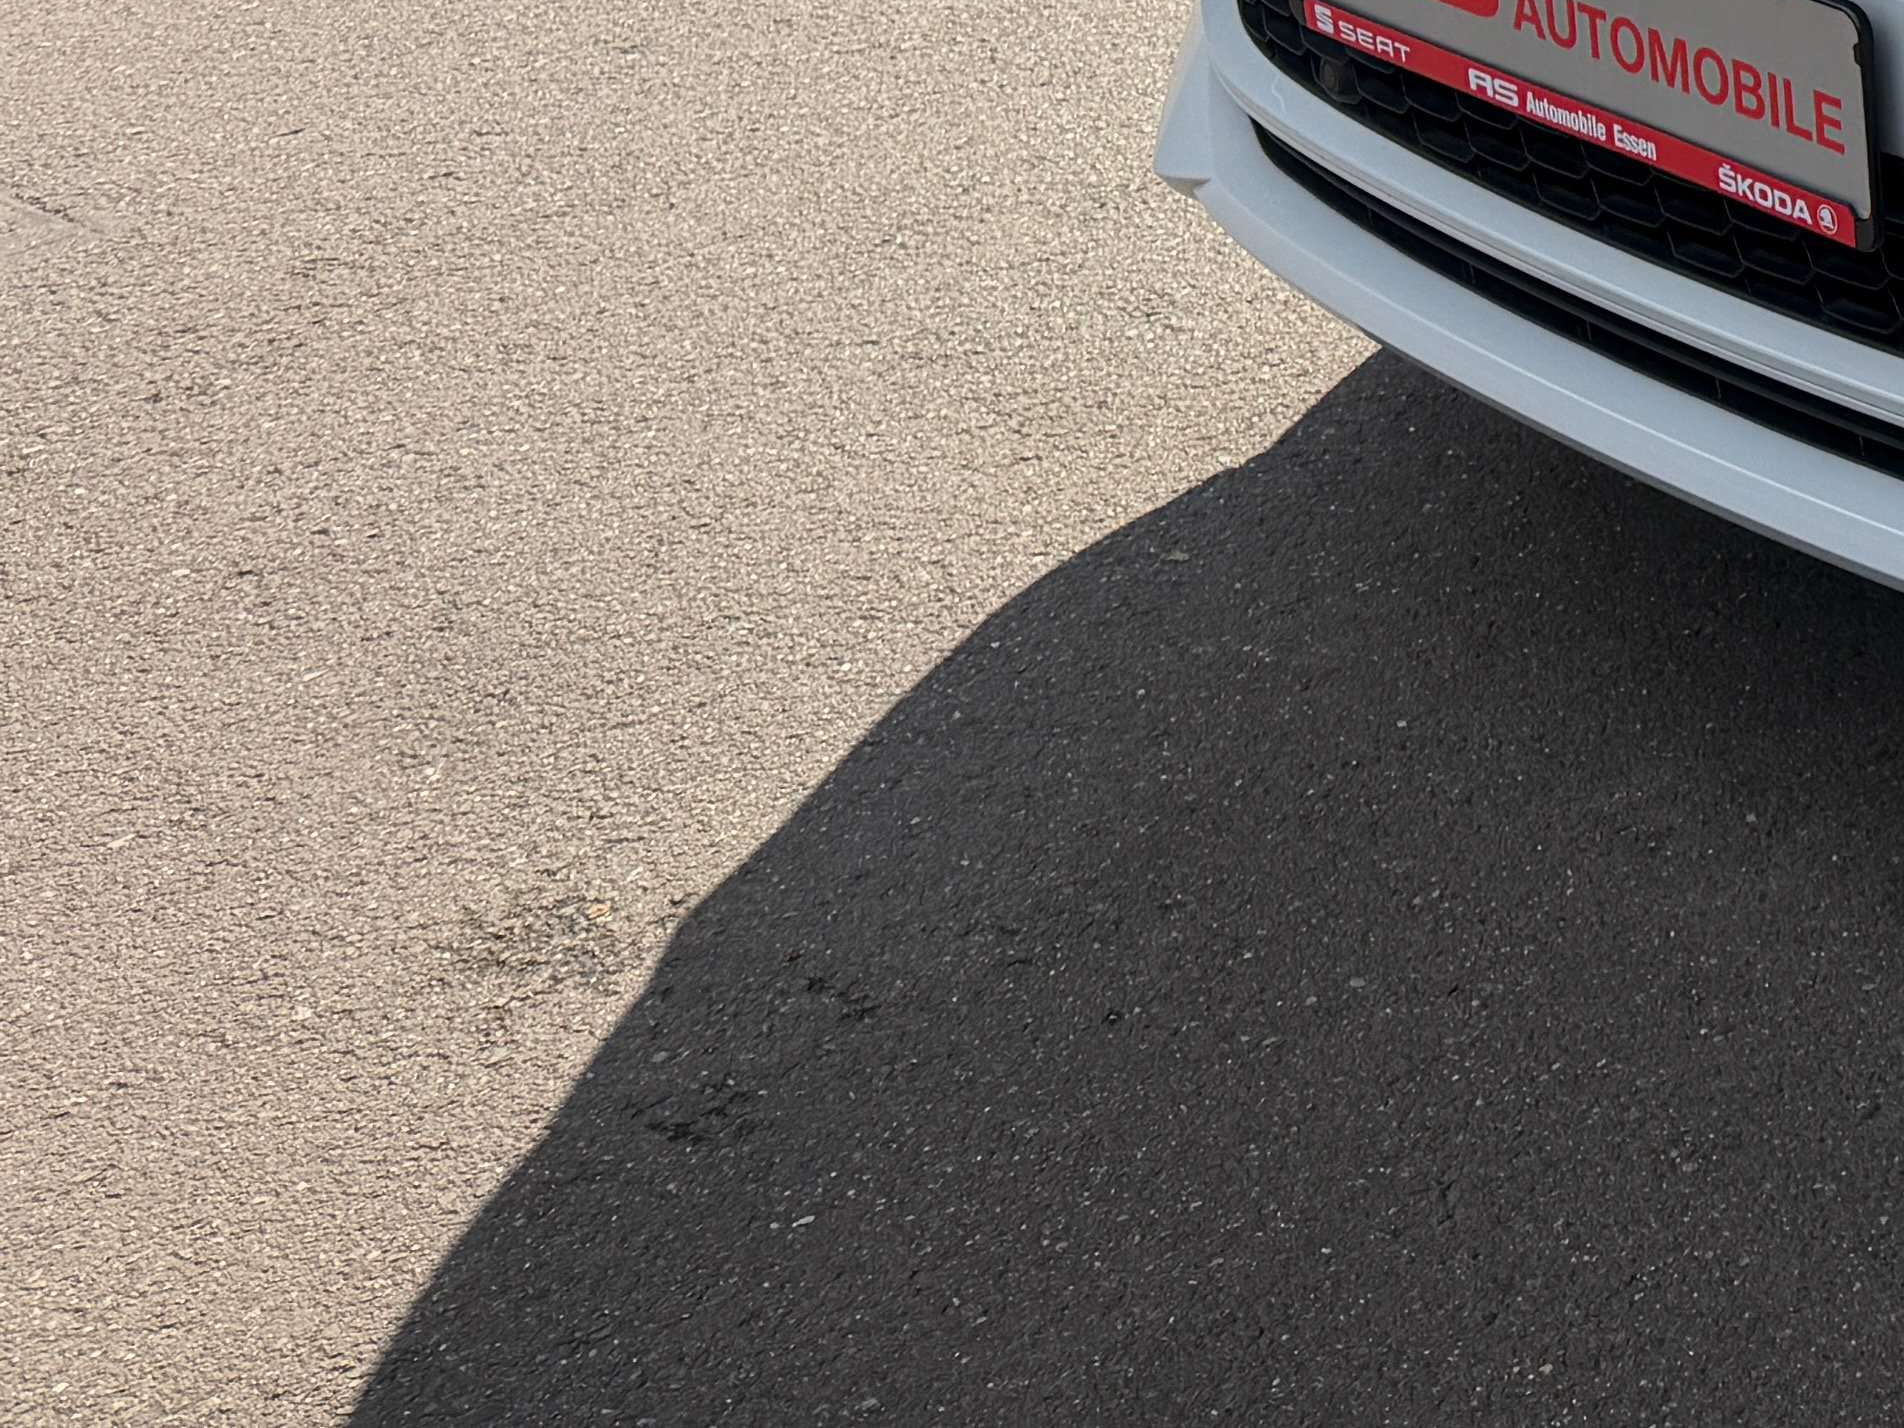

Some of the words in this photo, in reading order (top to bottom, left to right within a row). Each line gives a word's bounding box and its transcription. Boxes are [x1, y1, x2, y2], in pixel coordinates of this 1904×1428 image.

[1338, 20, 1412, 63] SEAT
[1467, 66, 1520, 108] AS
[1525, 89, 1607, 142] Automobile
[1612, 123, 1658, 162] Essen
[1717, 163, 1814, 226] ŠKODA
